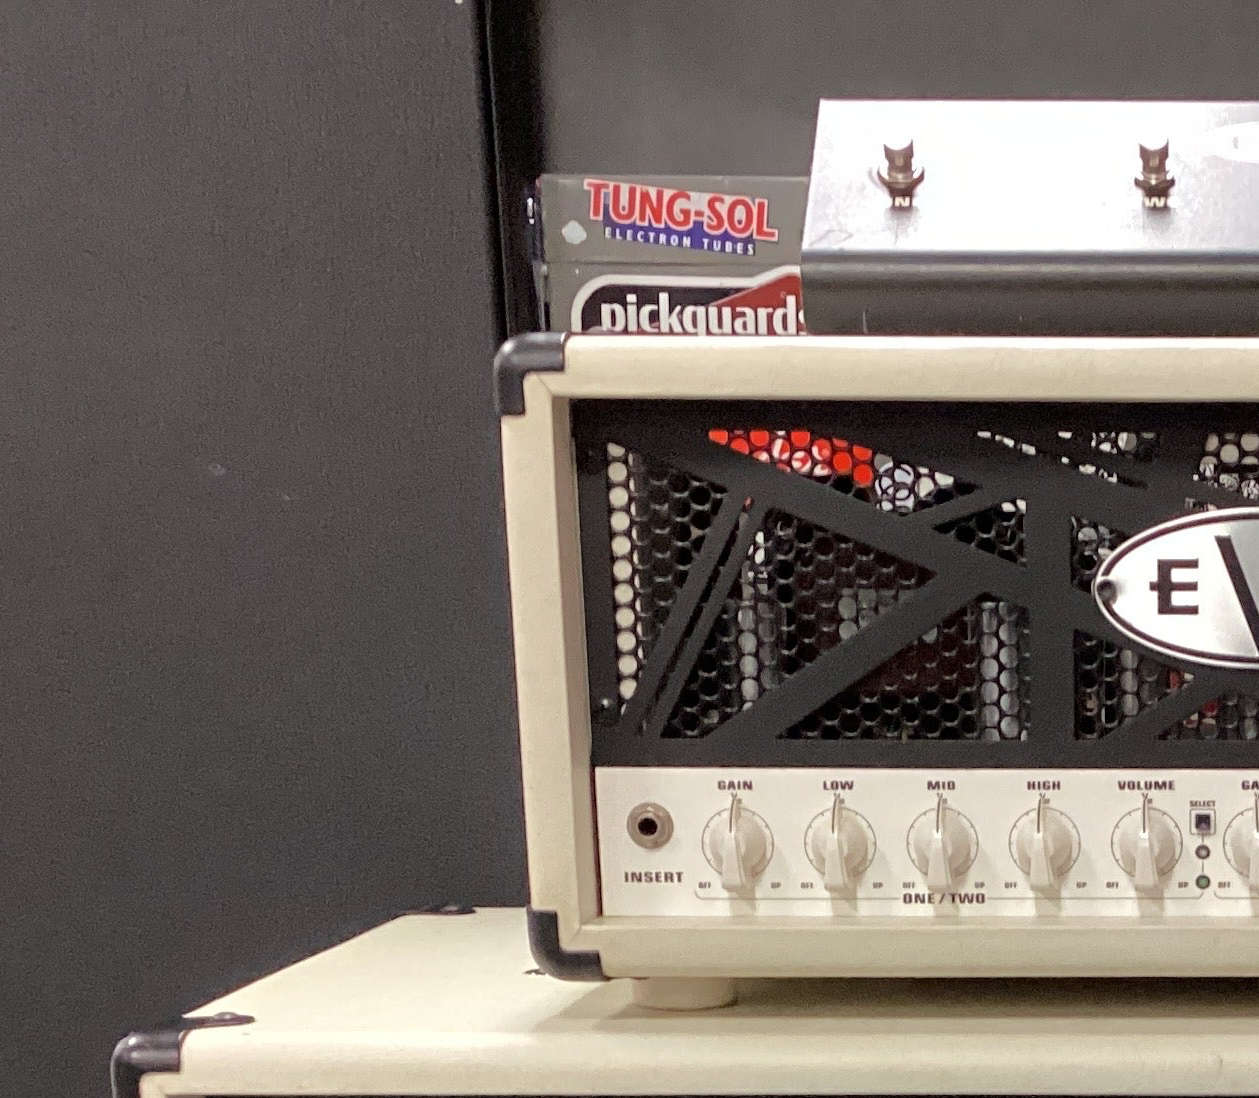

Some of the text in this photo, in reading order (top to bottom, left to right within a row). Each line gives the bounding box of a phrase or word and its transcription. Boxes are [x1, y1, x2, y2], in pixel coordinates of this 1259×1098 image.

[585, 179, 778, 241] TUNG-SOL
[604, 226, 756, 256] ELECTRON TUBES
[717, 780, 753, 791] GAIN
[822, 780, 854, 791] LOW
[926, 780, 956, 791] MID
[1027, 780, 1061, 791] HIGH
[1117, 780, 1175, 791] VOLUME
[624, 871, 683, 883] INSERT
